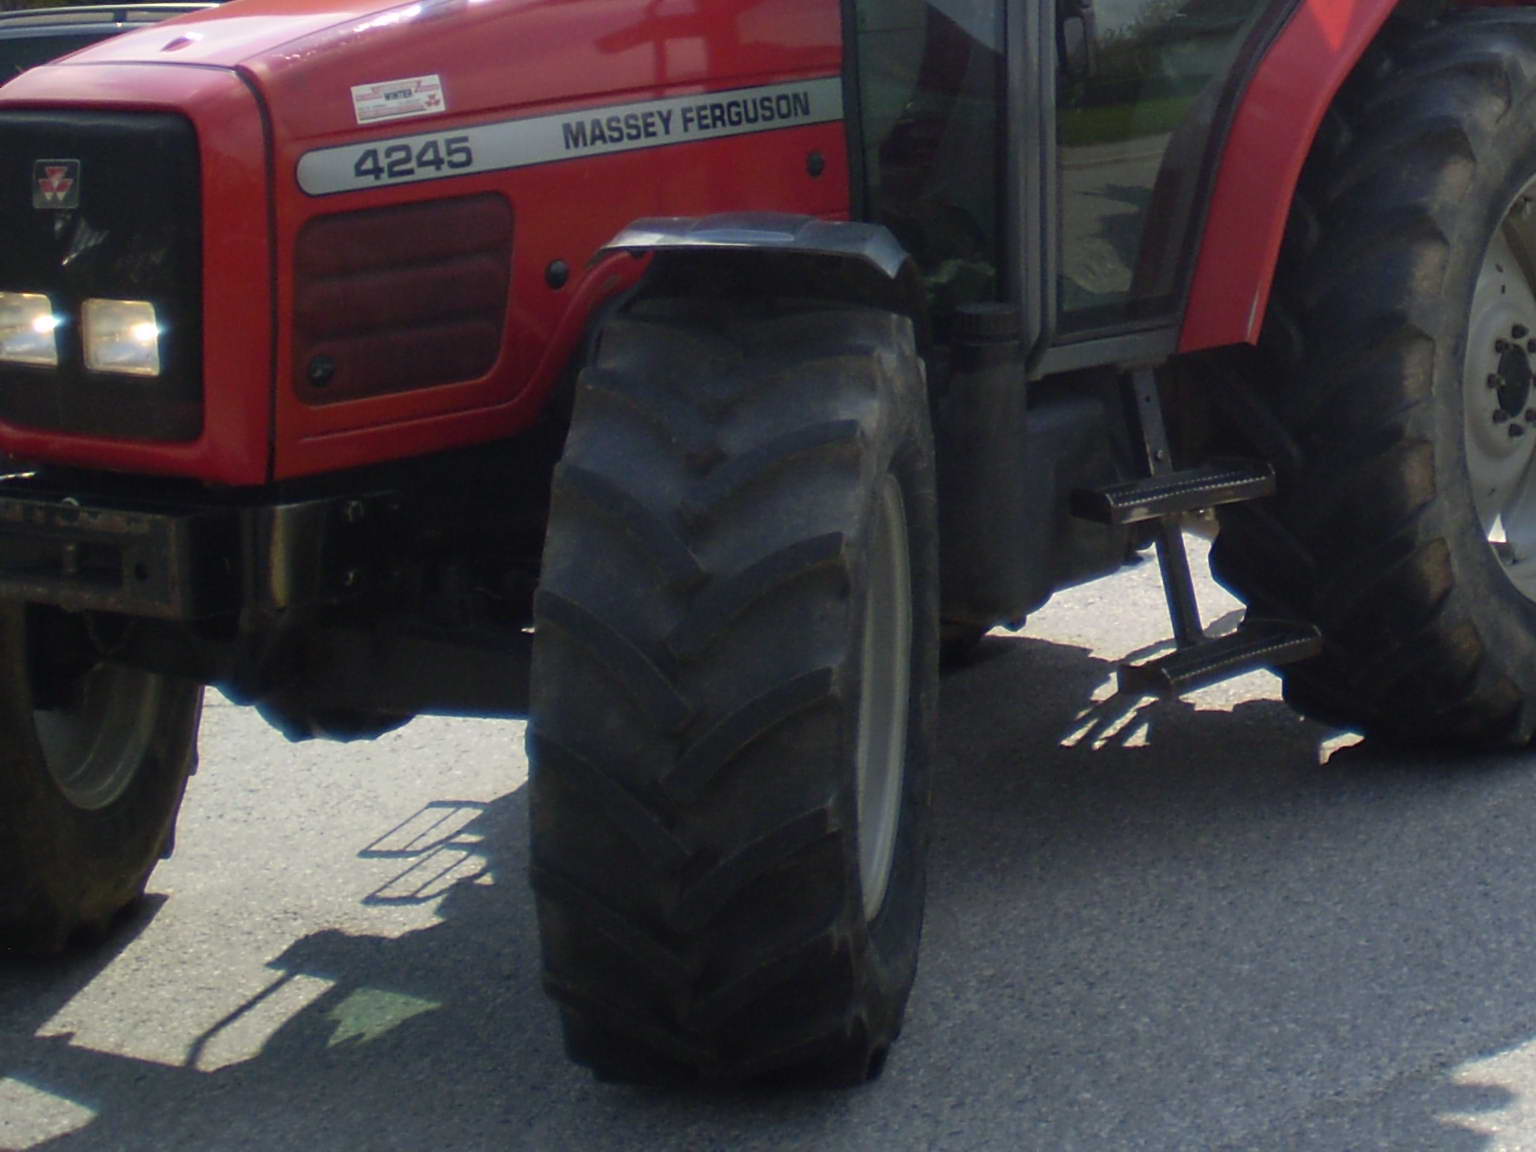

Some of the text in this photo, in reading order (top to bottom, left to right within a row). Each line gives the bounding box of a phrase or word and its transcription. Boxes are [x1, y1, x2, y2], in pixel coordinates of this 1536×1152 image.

[354, 91, 811, 181] 4245 MASSEY FERGUSON
